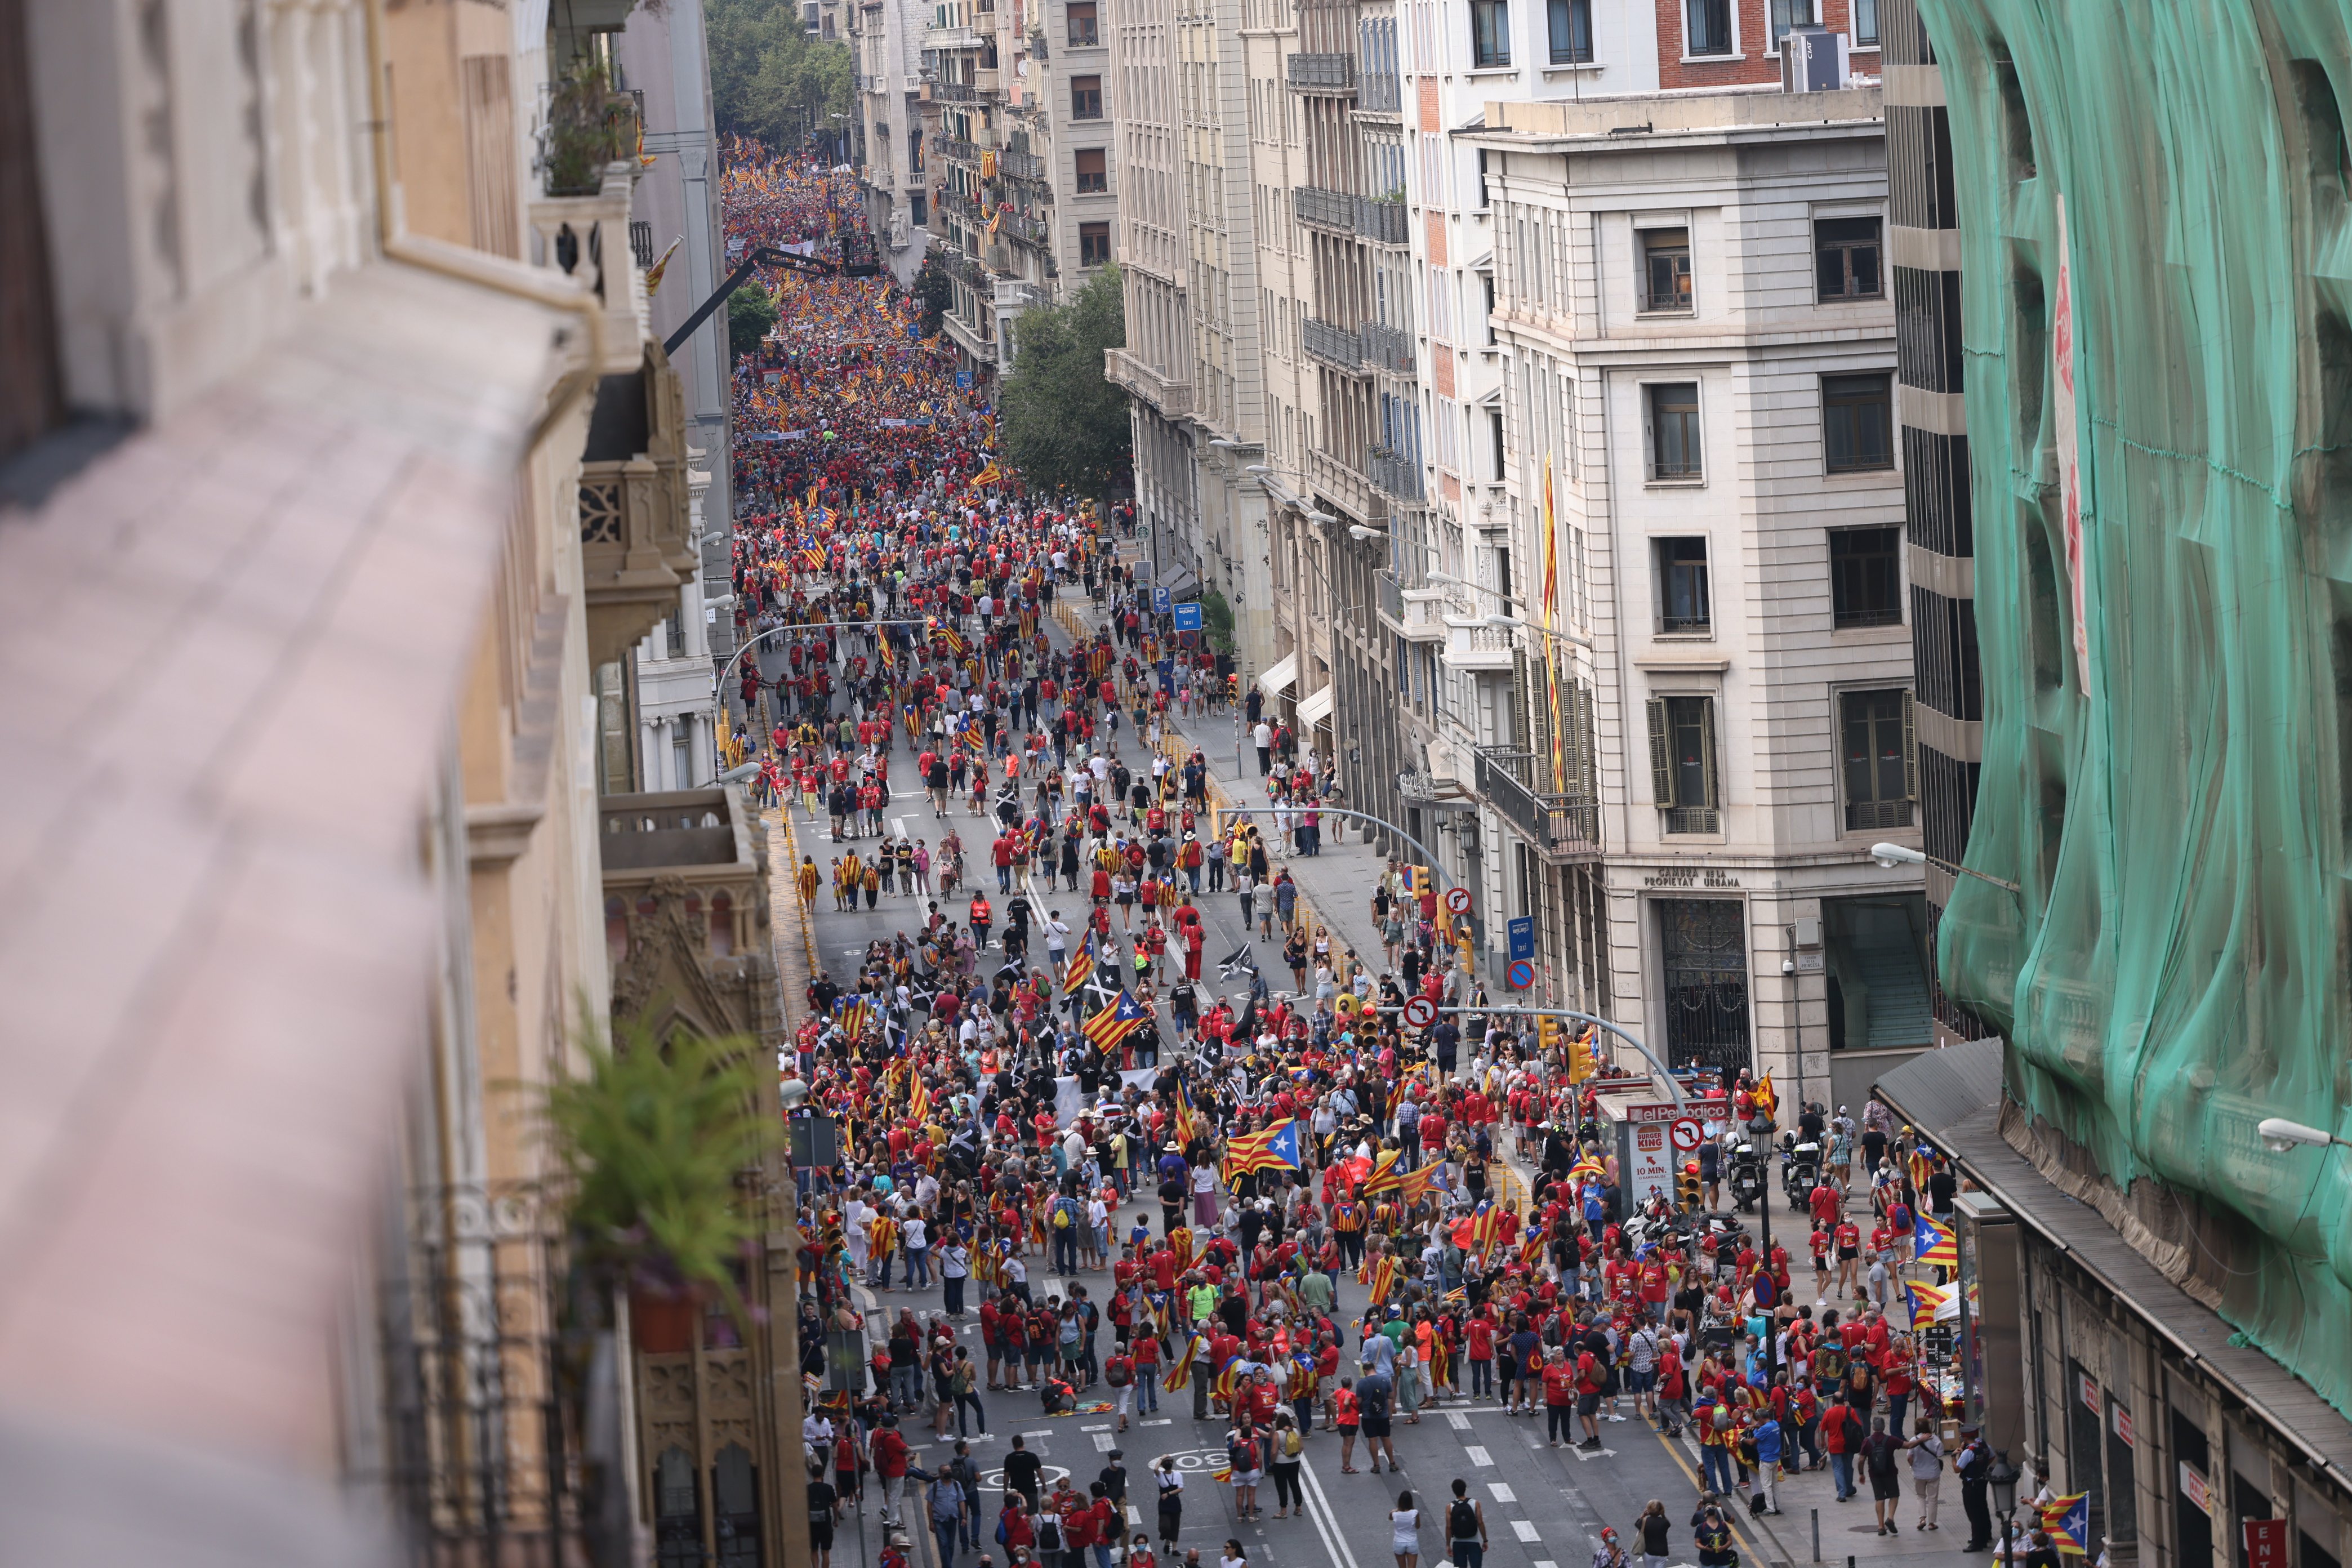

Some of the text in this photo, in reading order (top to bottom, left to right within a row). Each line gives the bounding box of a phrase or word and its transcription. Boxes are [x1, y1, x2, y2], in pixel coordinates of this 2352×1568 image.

[1156, 588, 1166, 602] P
[1659, 867, 1698, 877] CAMBRA
[1645, 877, 1740, 887] PROPIETAT URBANA
[1518, 943, 1527, 952] taxi
[1643, 1108, 1656, 1120] el
[1638, 1139, 1662, 1147] KING
